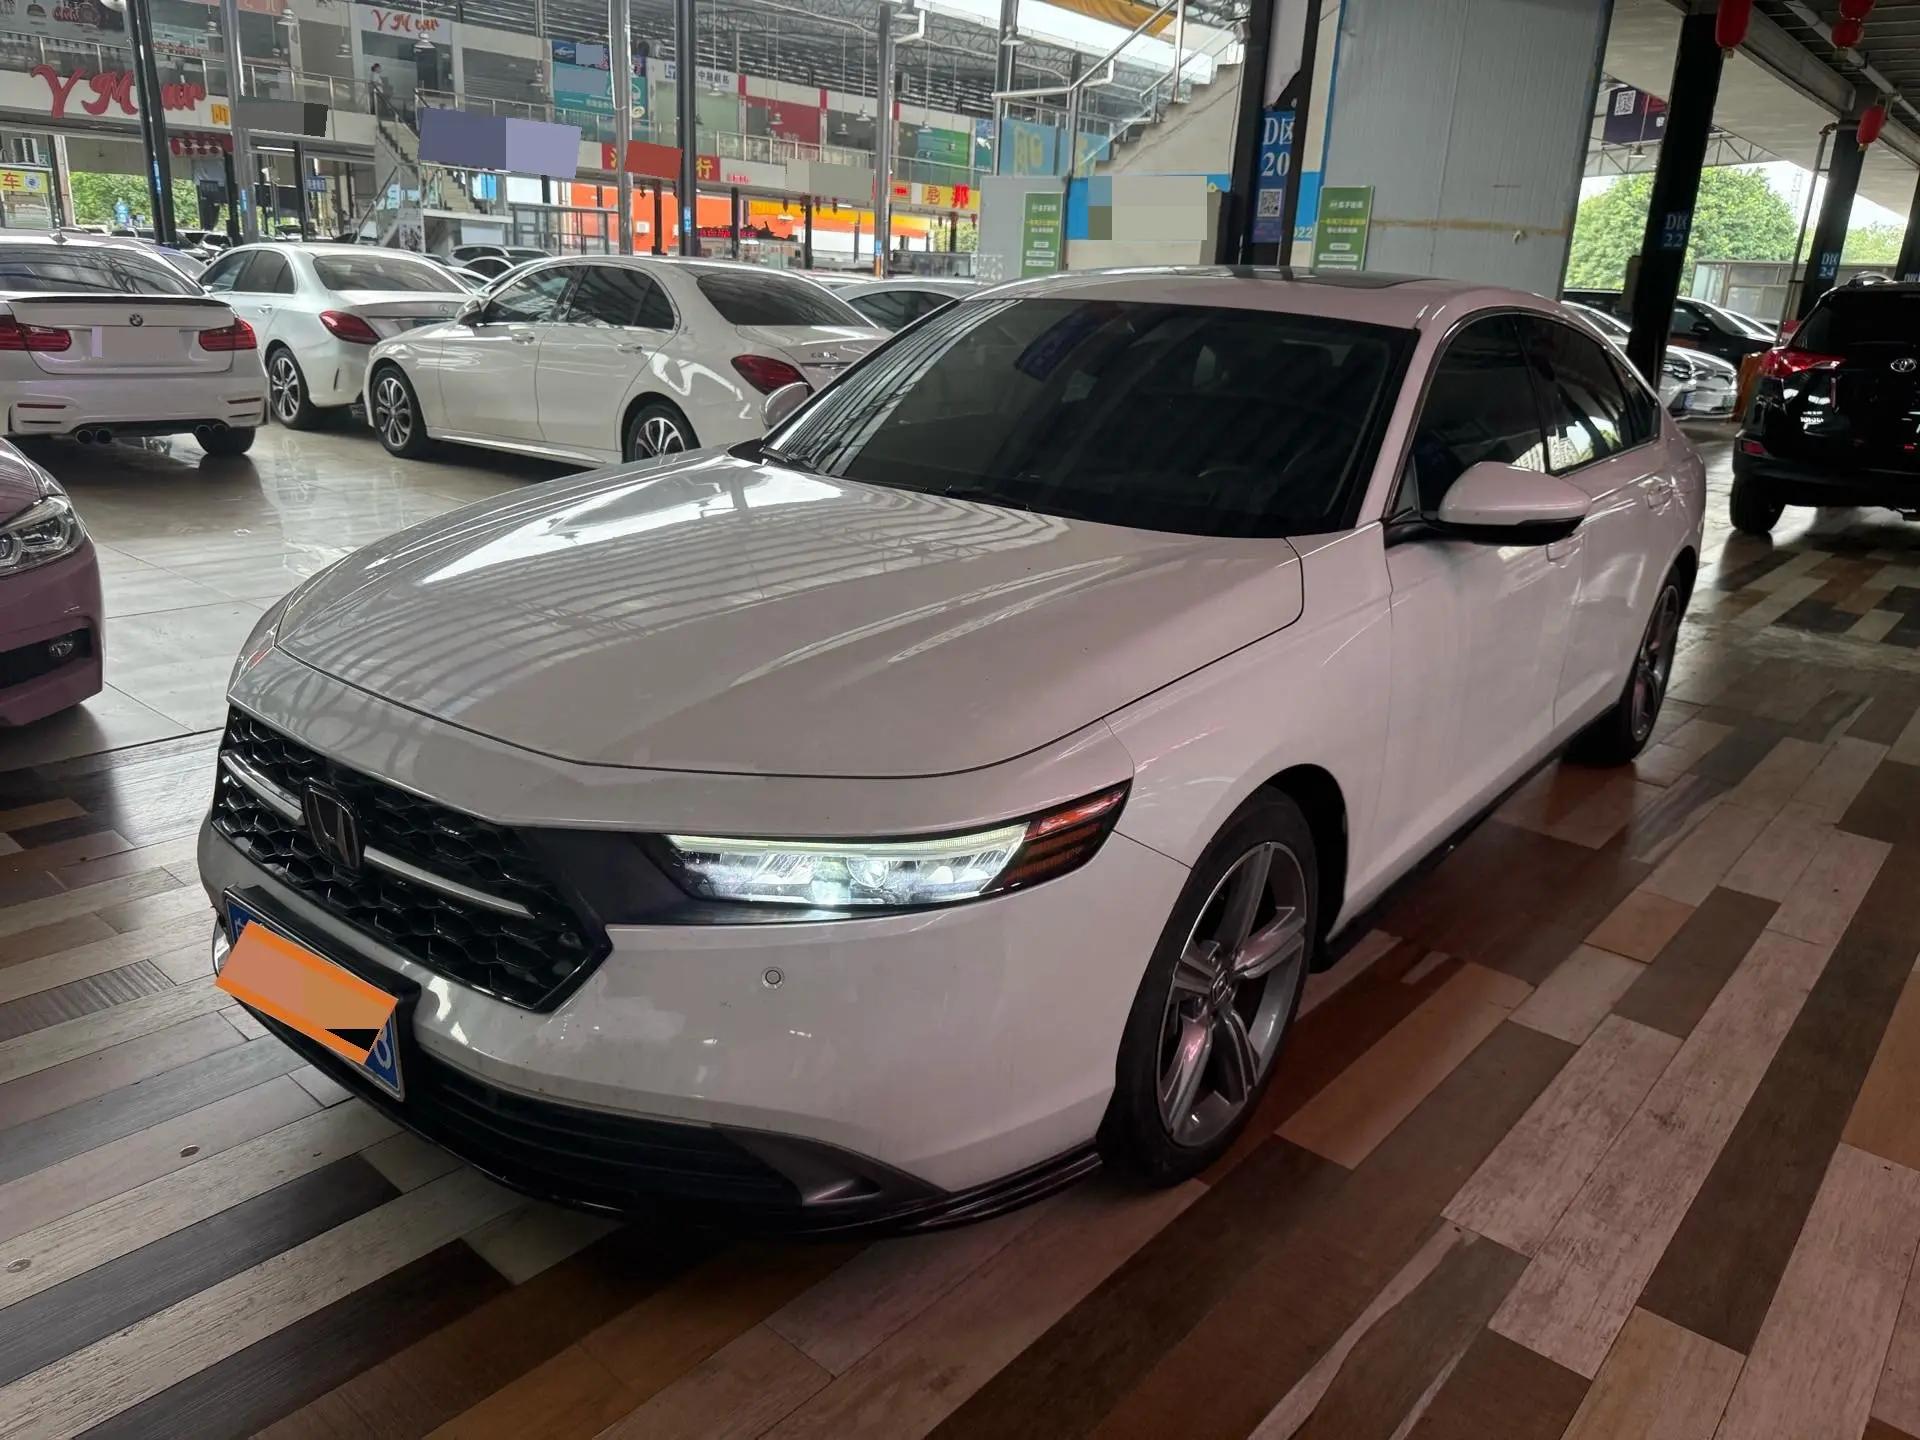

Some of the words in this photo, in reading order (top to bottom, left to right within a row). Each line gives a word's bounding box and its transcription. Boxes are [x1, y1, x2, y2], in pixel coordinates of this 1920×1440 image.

[1263, 117, 1296, 145] D区
[1261, 152, 1291, 177] 20
[2, 172, 21, 189] 车
[1663, 233, 1684, 247] 22
[1819, 266, 1835, 277] 24
